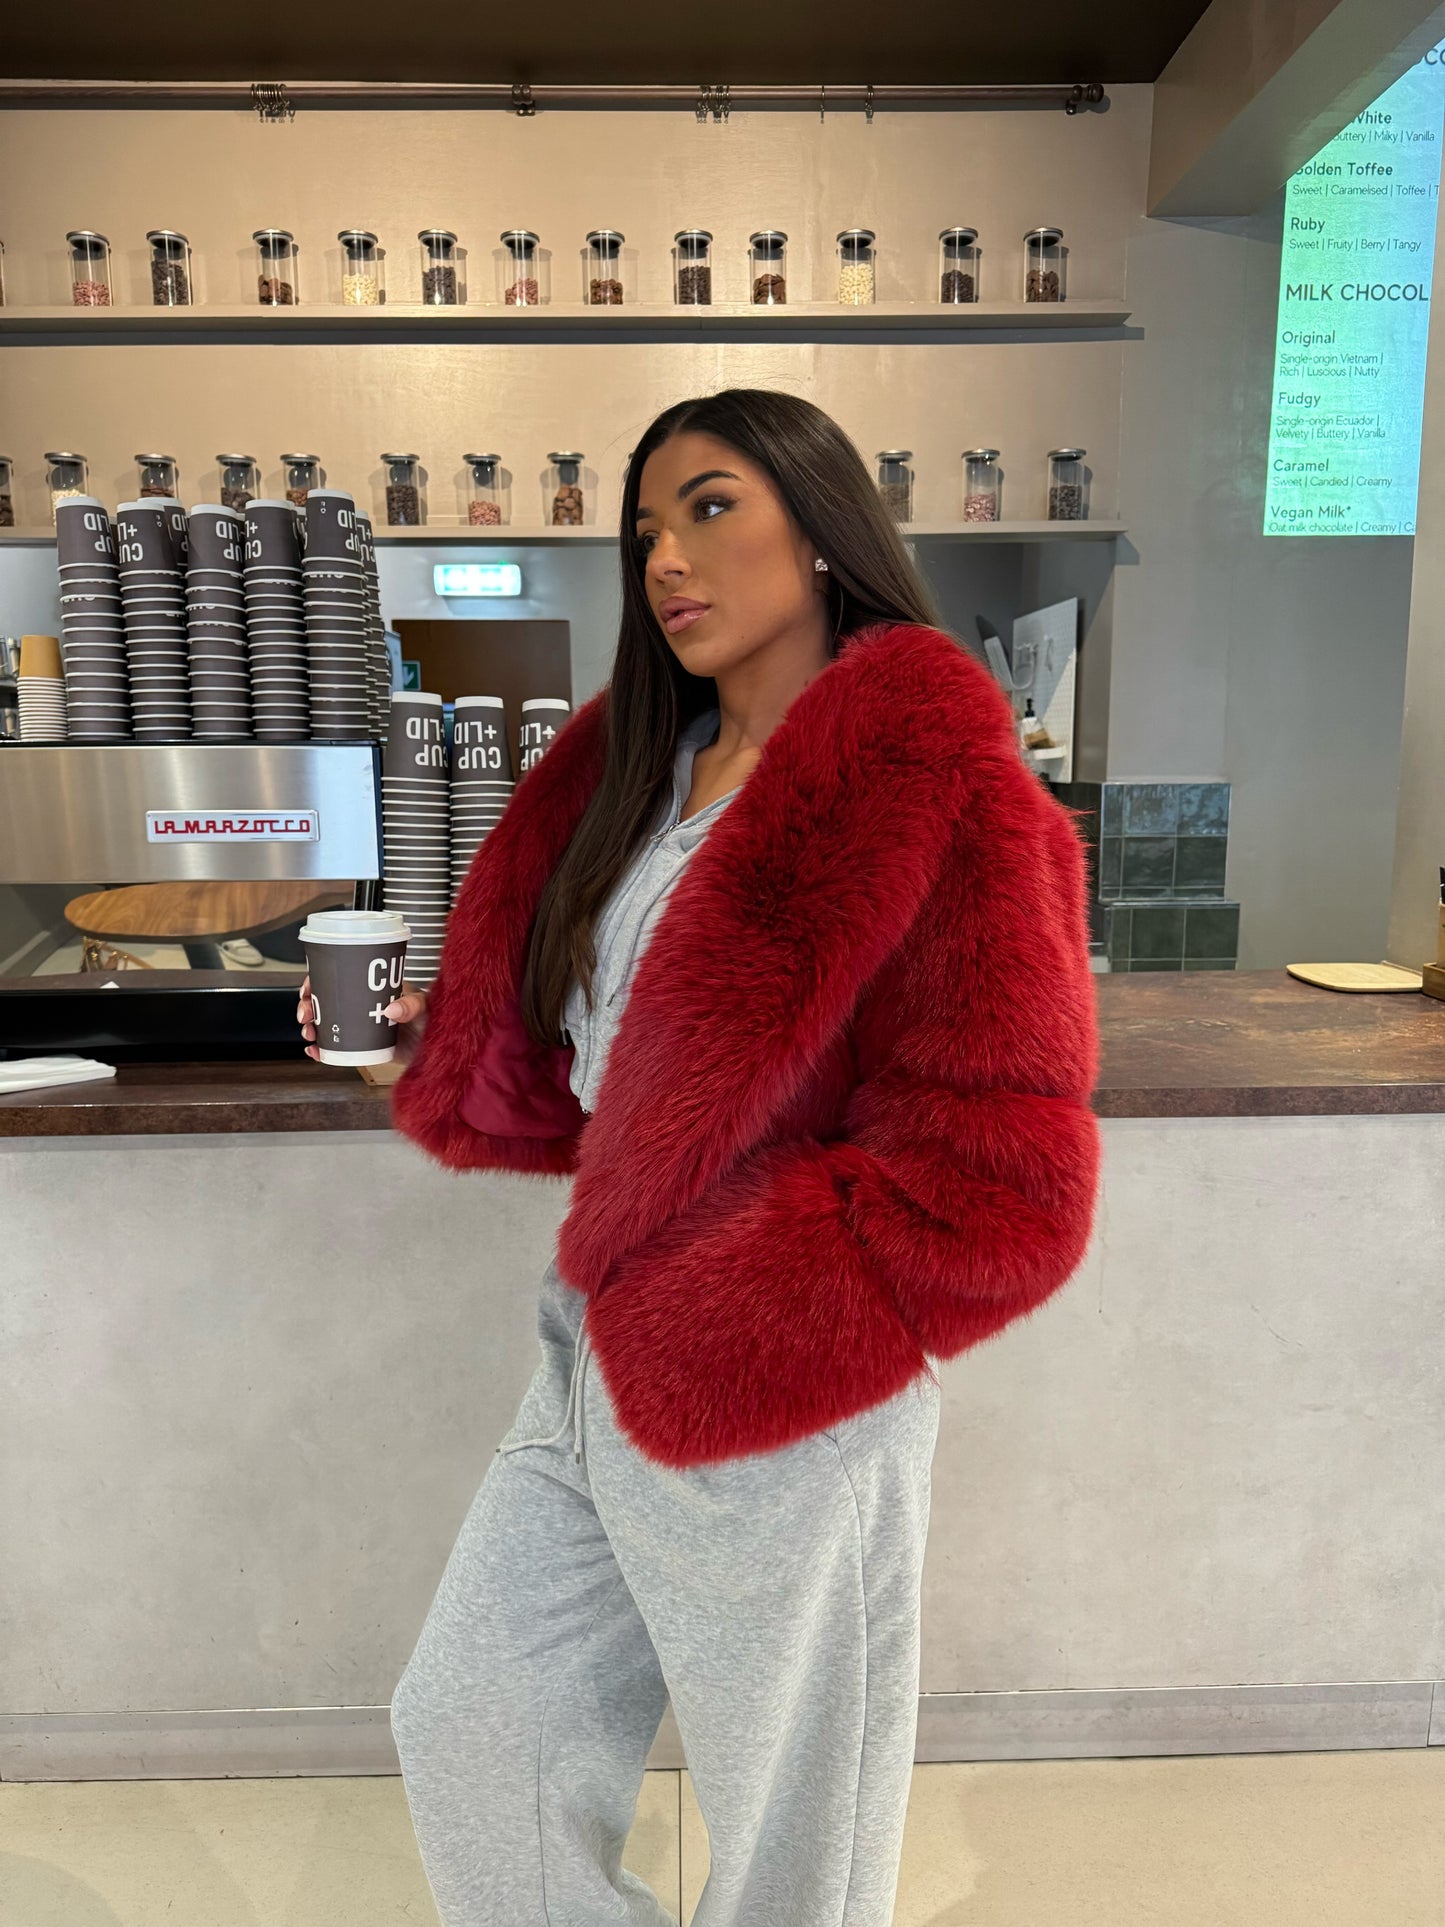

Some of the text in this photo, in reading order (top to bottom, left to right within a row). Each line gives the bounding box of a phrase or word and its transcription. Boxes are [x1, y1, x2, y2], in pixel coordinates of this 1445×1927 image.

[1406, 130, 1435, 141] Vanilla
[1347, 162, 1393, 176] Toffee
[1292, 184, 1322, 195] Sweet
[1330, 184, 1389, 195] Caramelised
[1396, 184, 1426, 195] Toffee
[1290, 217, 1325, 234] Ruby
[1289, 238, 1319, 250] Sweet
[1327, 238, 1353, 251] Fruity
[1361, 238, 1385, 251] Berry
[1392, 239, 1422, 252] Tangy
[1286, 283, 1429, 301] MILK CHOCOL
[1282, 330, 1336, 347] Original
[1280, 353, 1338, 366] Single-origin
[1340, 353, 1378, 364] Vietnam
[1279, 366, 1299, 377] Rich
[1307, 366, 1346, 377] Luscious
[1354, 366, 1380, 379] Nutty
[1278, 391, 1321, 408] Fudgy
[1276, 415, 1334, 428] Single-origin
[1336, 415, 1375, 426] Ecuador
[1276, 428, 1309, 440] Velvety
[1316, 428, 1350, 440] Buttery
[1357, 427, 1386, 438] Vanilla
[1273, 458, 1329, 472] Caramel
[1273, 476, 1302, 487] Sweet
[1310, 476, 1349, 487] Candied
[1356, 476, 1392, 488] Creamy
[1271, 505, 1313, 522] Vegan
[1308, 521, 1354, 533] chocolate
[1360, 521, 1397, 533] Creamy
[454, 720, 497, 745] +LID
[458, 746, 501, 770] CUP
